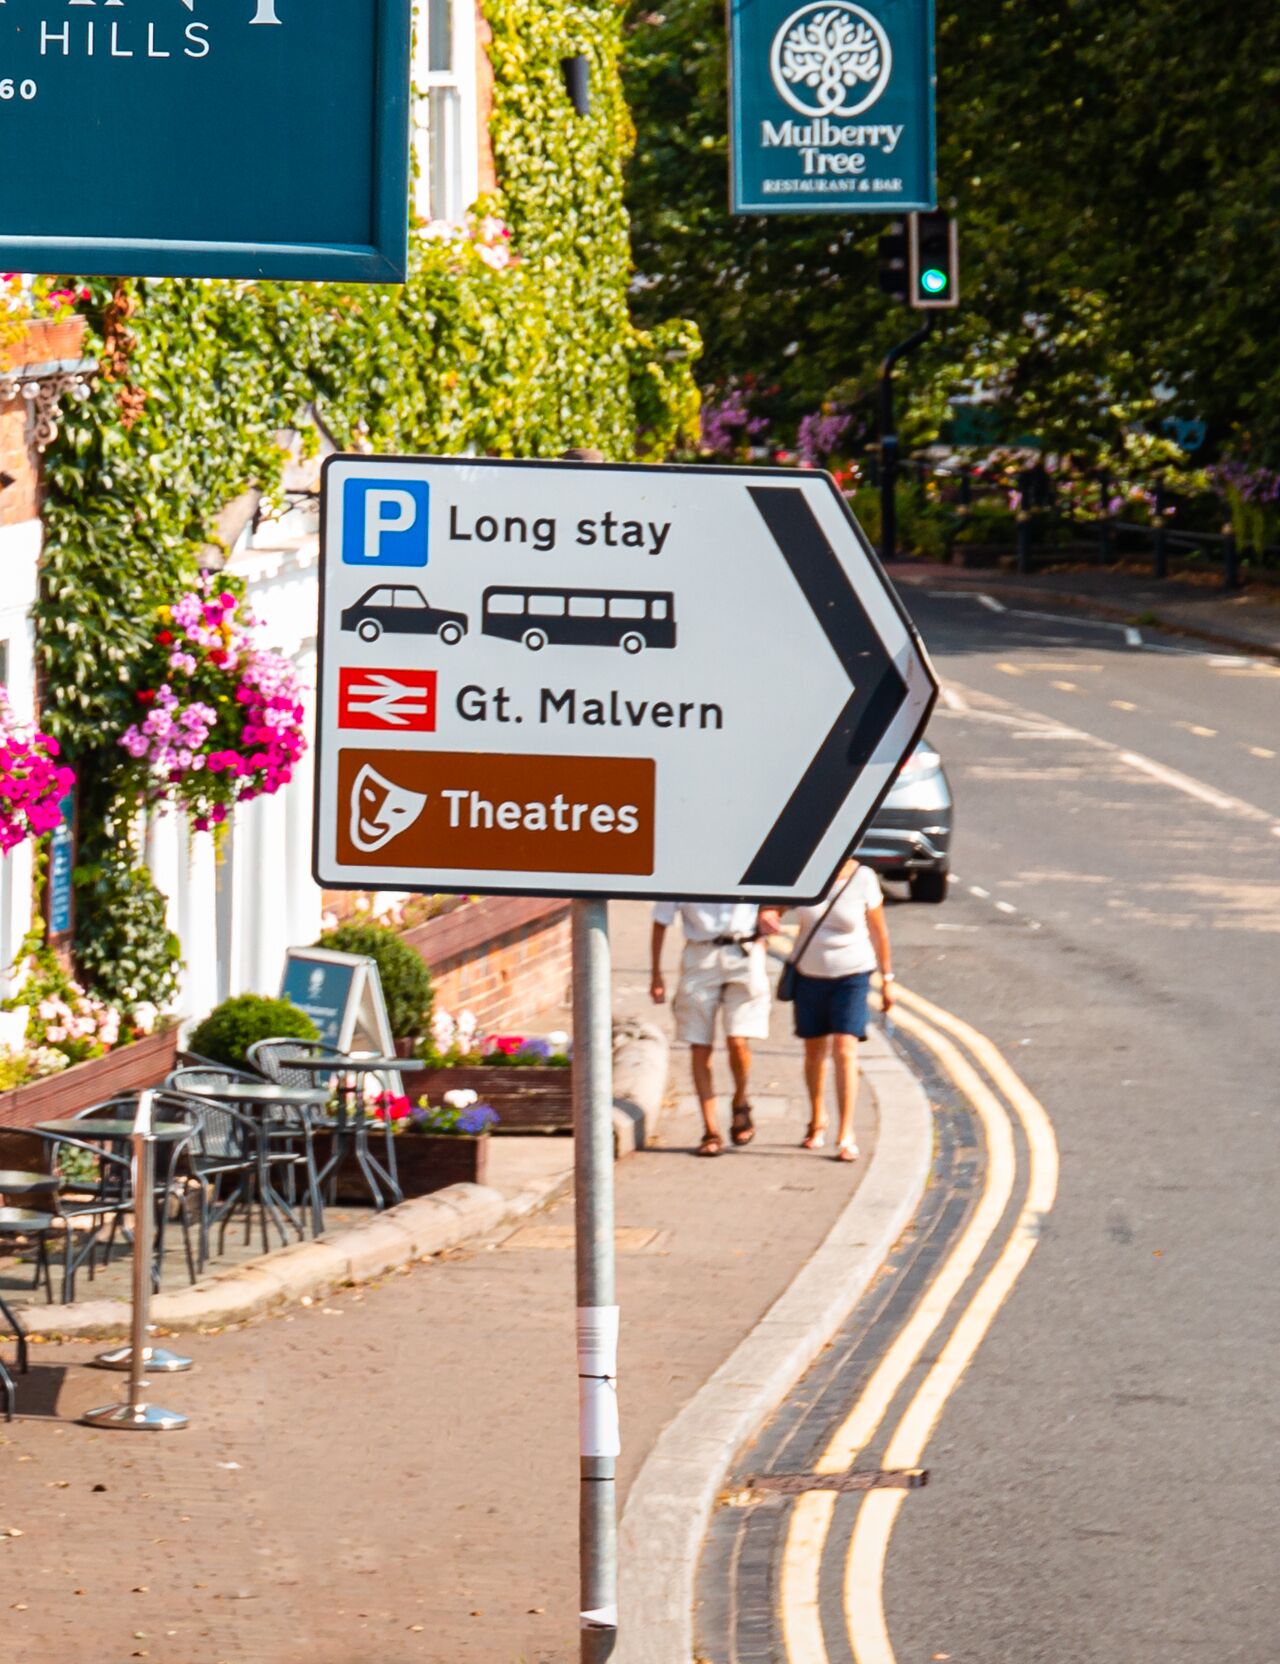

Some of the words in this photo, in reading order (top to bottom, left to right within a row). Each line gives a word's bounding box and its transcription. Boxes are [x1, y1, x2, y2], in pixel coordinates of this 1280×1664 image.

[40, 20, 210, 58] HILLS
[761, 117, 904, 154] Mulberry
[797, 147, 866, 175] Tree
[364, 488, 416, 557] P
[449, 505, 556, 552] Long
[575, 511, 672, 556] stay
[456, 684, 523, 724] Gt.
[539, 687, 723, 730] Malvern
[440, 789, 639, 834] Theatres
